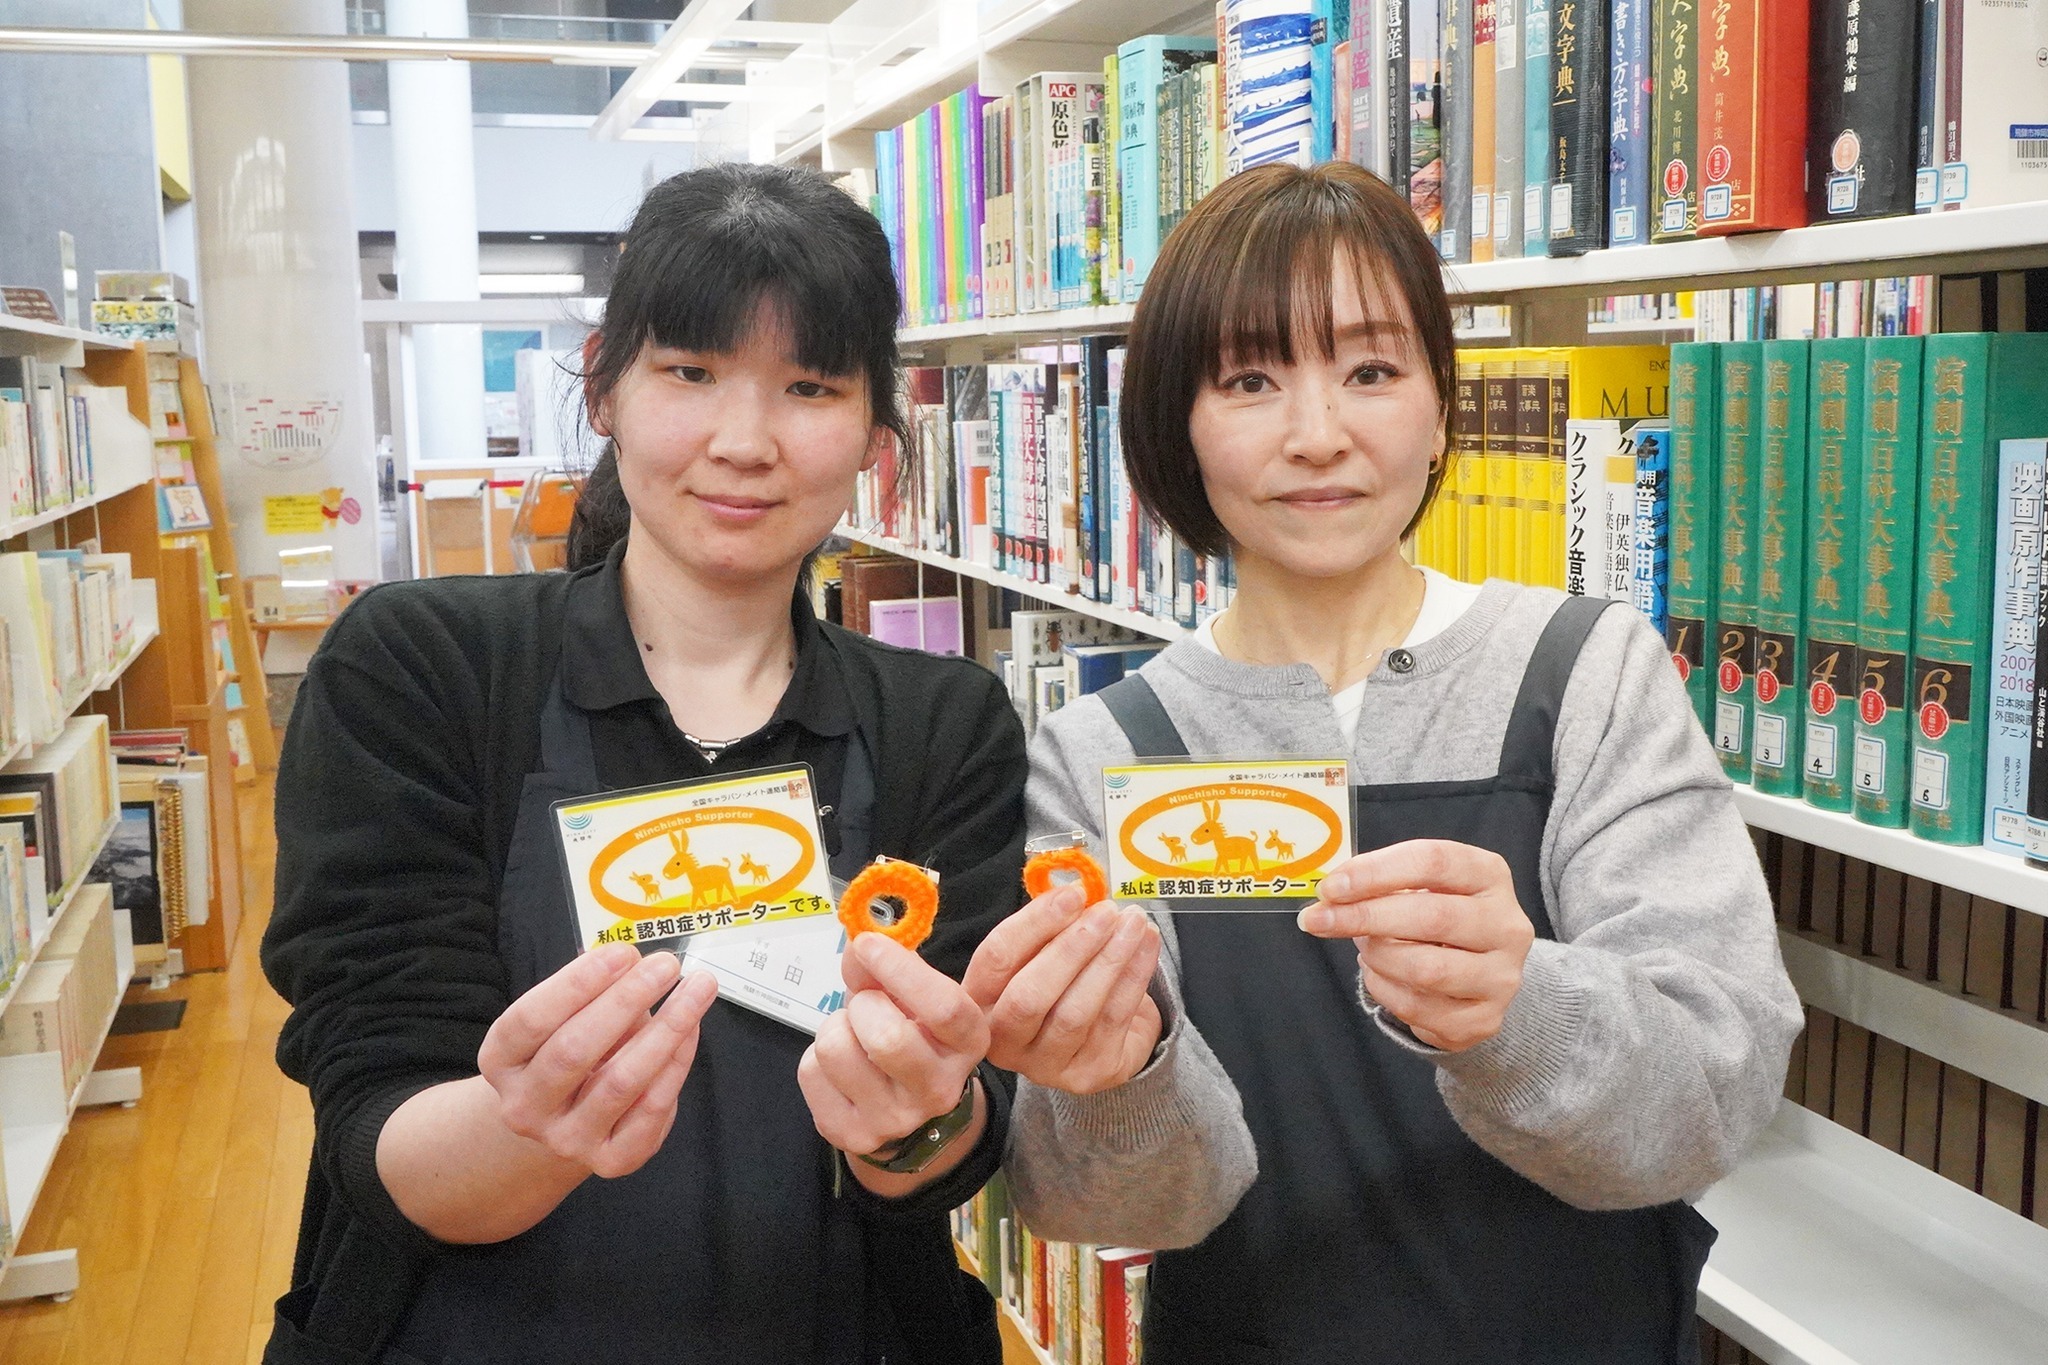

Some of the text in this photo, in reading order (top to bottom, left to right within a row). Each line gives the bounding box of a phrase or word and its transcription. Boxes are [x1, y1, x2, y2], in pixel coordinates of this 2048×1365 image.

[1556, 3, 1576, 98] 文字典
[1613, 2, 1629, 142] 書き方字典
[1049, 84, 1076, 97] APG
[2004, 462, 2043, 654] 映画原作事典
[1676, 625, 1689, 654] 1
[1719, 630, 1746, 662] 2
[1756, 639, 1784, 673] 3
[2000, 655, 2036, 672] 2007
[1811, 651, 1839, 687] 4
[1860, 659, 1890, 692] 5
[1920, 668, 1953, 706] 6
[1999, 675, 2035, 693] 2018
[2000, 726, 2029, 738] アニメ
[1723, 735, 1730, 749] 2
[1763, 748, 1770, 760] 3
[1813, 758, 1823, 774] 4
[1863, 774, 1872, 787] 5
[1169, 787, 1288, 805] Ninchisho Supporter
[1922, 789, 1930, 803] 6
[634, 810, 754, 841] Ninchisho Supporter
[2002, 815, 2018, 825] R778
